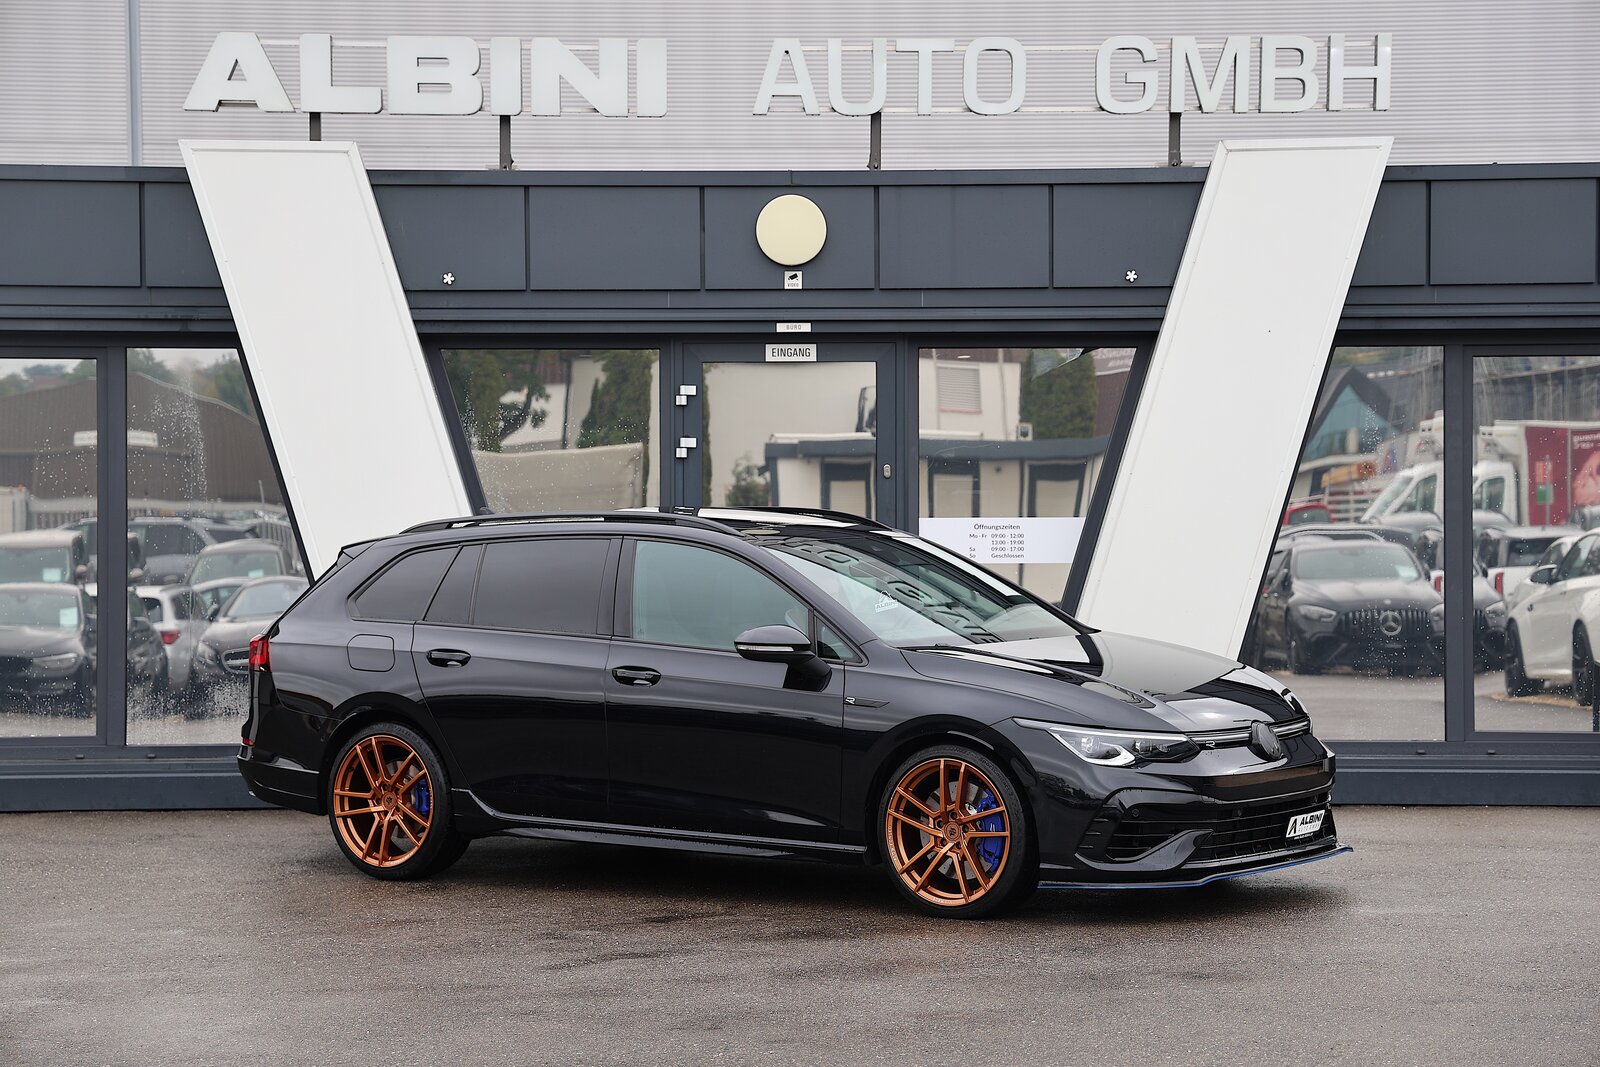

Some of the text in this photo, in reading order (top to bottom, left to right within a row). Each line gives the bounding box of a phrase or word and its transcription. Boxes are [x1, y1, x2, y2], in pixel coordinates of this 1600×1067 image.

[182, 31, 1393, 117] ALBINI AUTO GMBH
[771, 347, 811, 358] EINGANG
[1299, 813, 1323, 826] ALBINI
